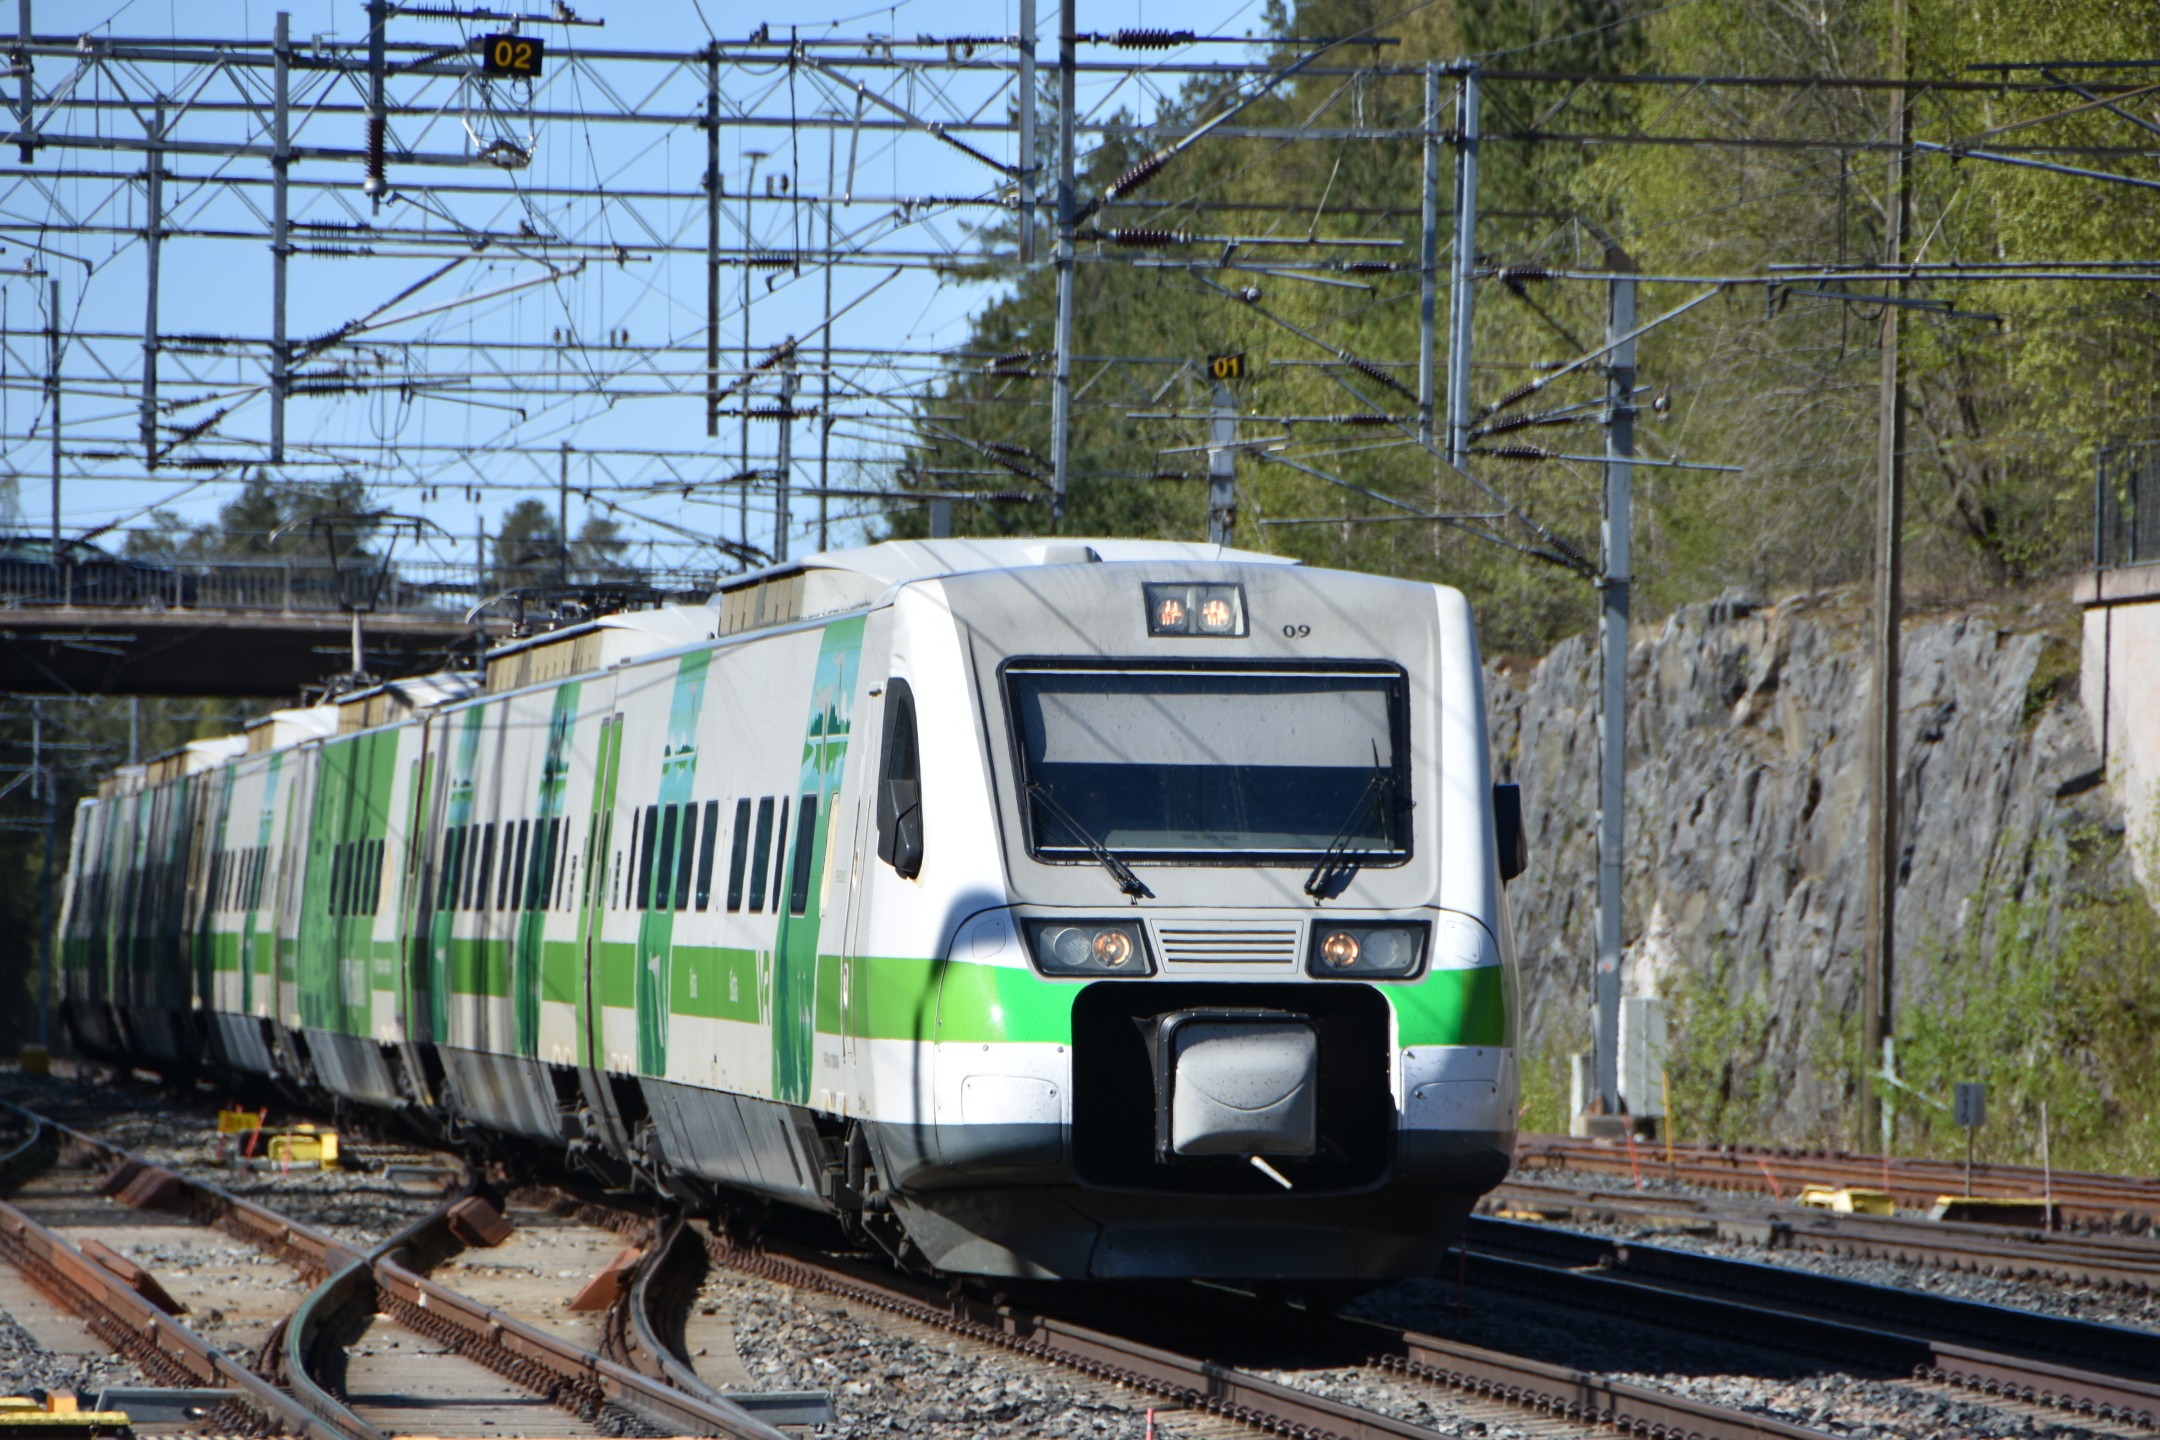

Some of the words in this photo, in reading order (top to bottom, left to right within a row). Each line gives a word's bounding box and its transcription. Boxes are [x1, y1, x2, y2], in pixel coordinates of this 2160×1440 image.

[494, 40, 532, 69] 02
[1213, 356, 1239, 379] 01
[1282, 624, 1311, 639] 09
[755, 950, 771, 1025] VR
